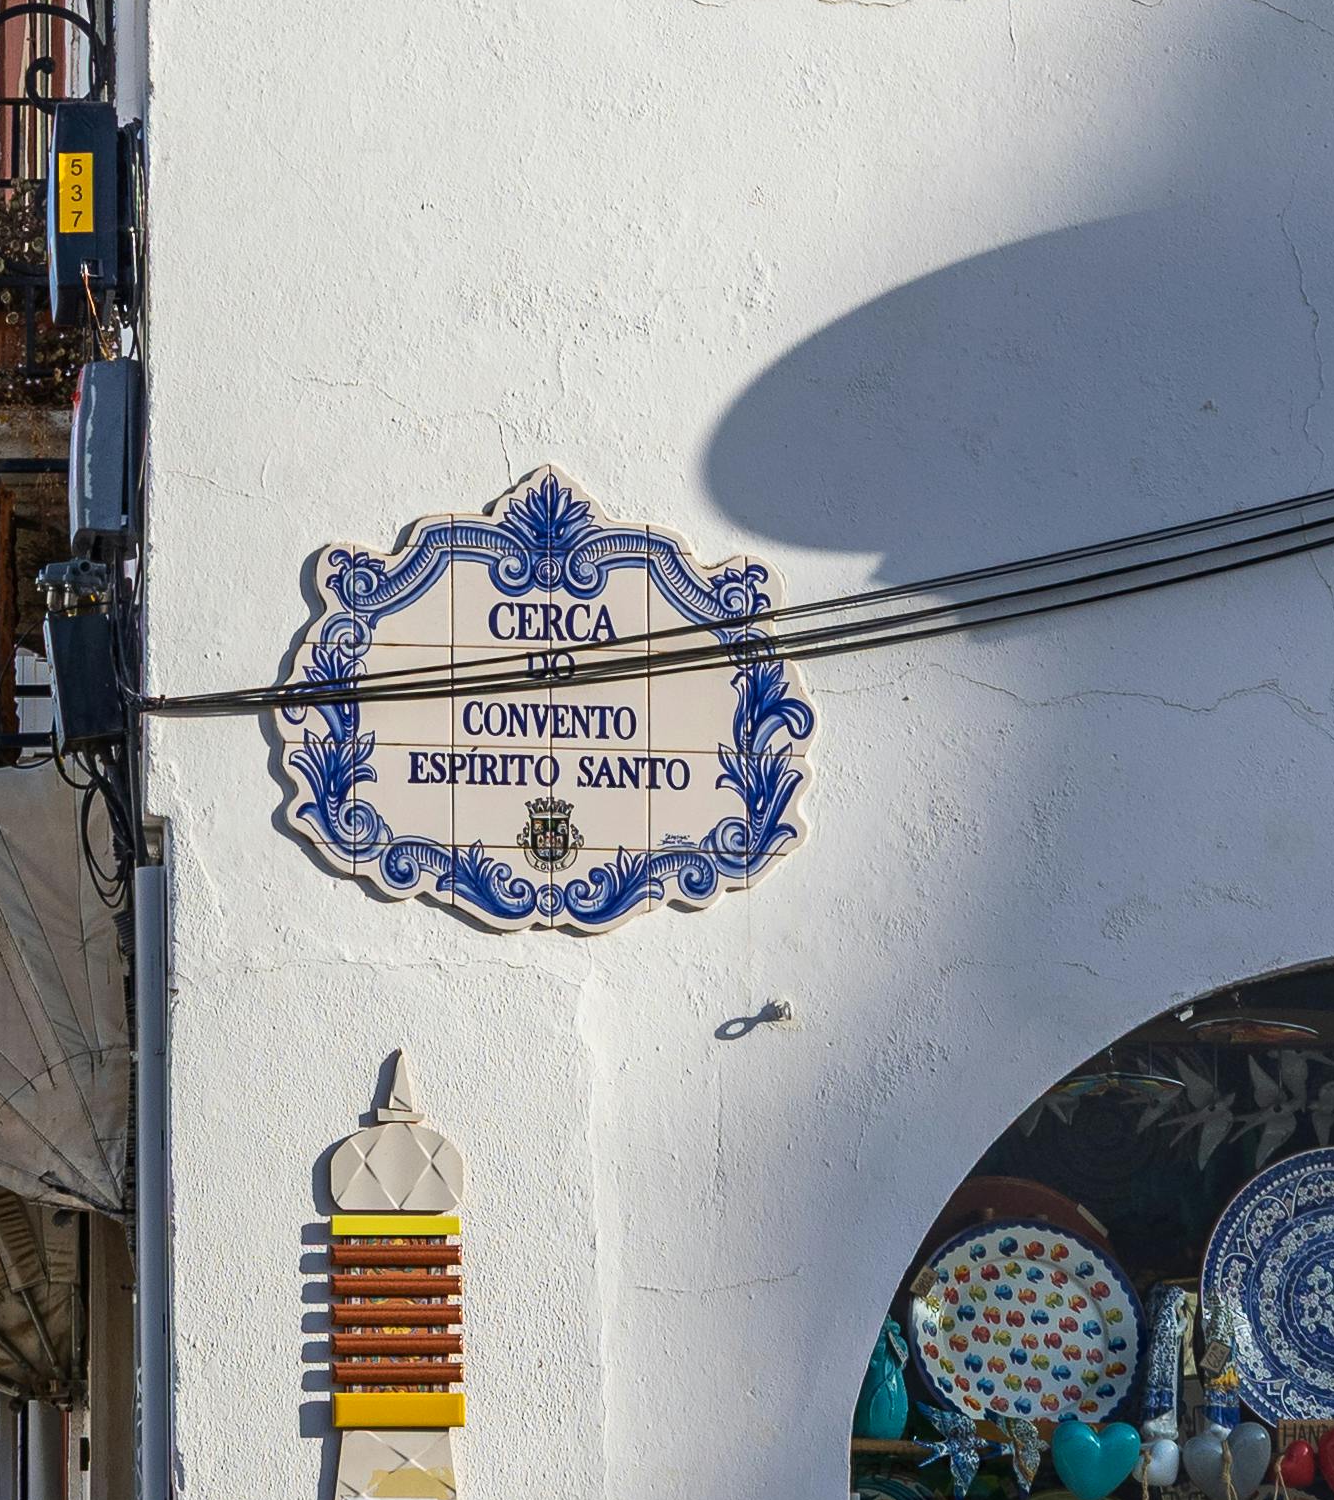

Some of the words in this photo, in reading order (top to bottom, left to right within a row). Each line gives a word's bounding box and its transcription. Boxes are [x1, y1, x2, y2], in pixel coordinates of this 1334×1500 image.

[487, 601, 618, 643] CERCA
[525, 652, 576, 681] DO
[461, 700, 638, 741] CONVENTO
[407, 746, 560, 787] ESPÍRITO
[577, 755, 691, 792] SANTO
